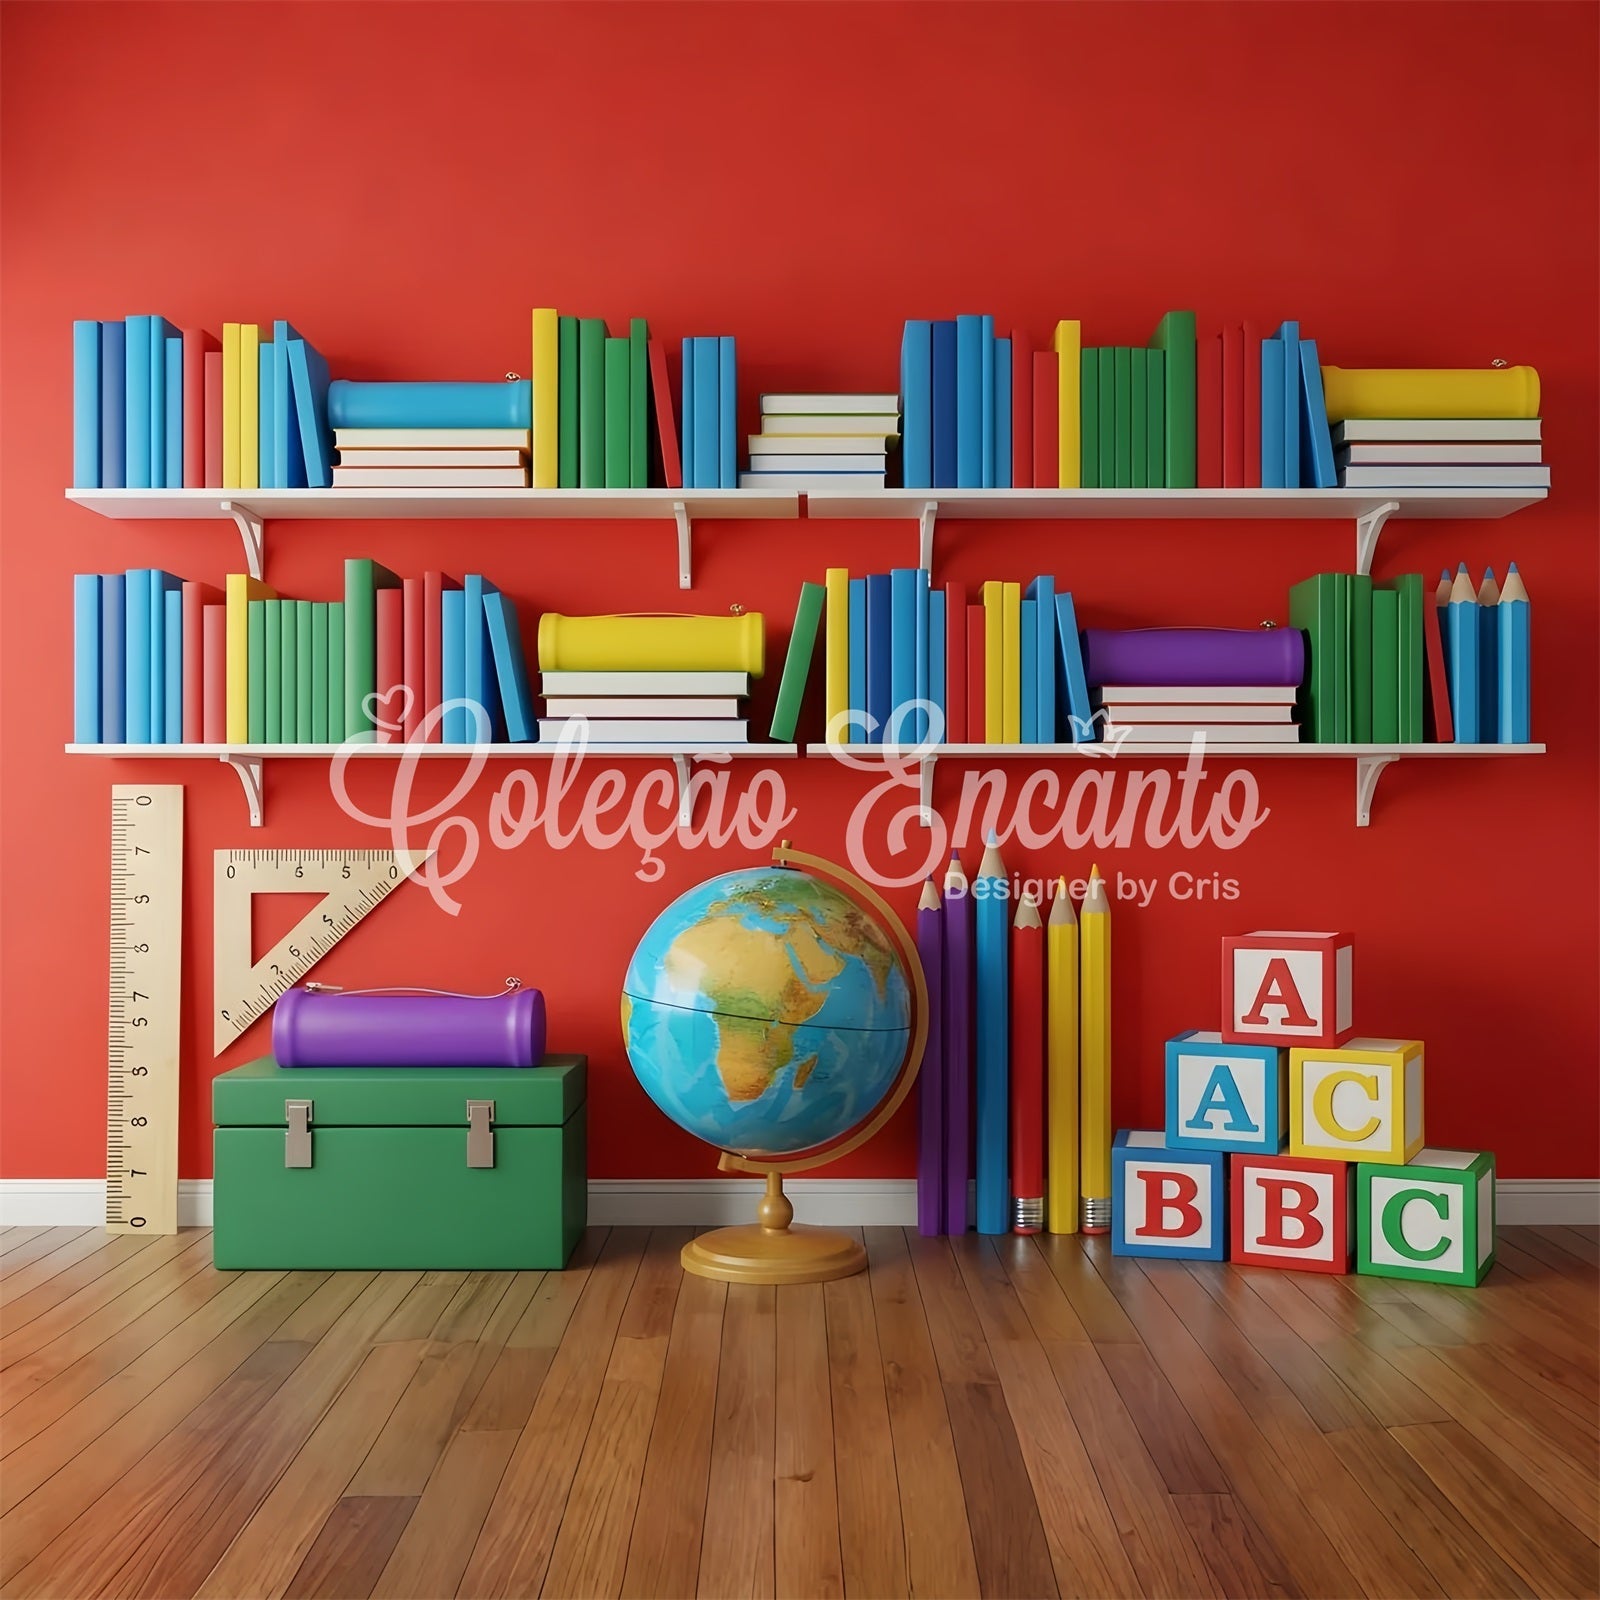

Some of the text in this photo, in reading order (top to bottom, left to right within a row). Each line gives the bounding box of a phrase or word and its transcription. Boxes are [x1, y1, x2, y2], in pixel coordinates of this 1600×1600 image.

[136, 795, 152, 806] 0
[135, 846, 151, 856] 7
[226, 865, 236, 879] 0
[389, 865, 398, 879] 0
[133, 991, 150, 1002] 7
[1242, 957, 1318, 1027] A
[1185, 1064, 1260, 1133] A
[1313, 1070, 1382, 1142] C
[131, 1116, 148, 1127] 8
[130, 1216, 147, 1228] 0
[1135, 1170, 1203, 1239] B
[1255, 1177, 1324, 1249] B
[1381, 1188, 1453, 1262] C
